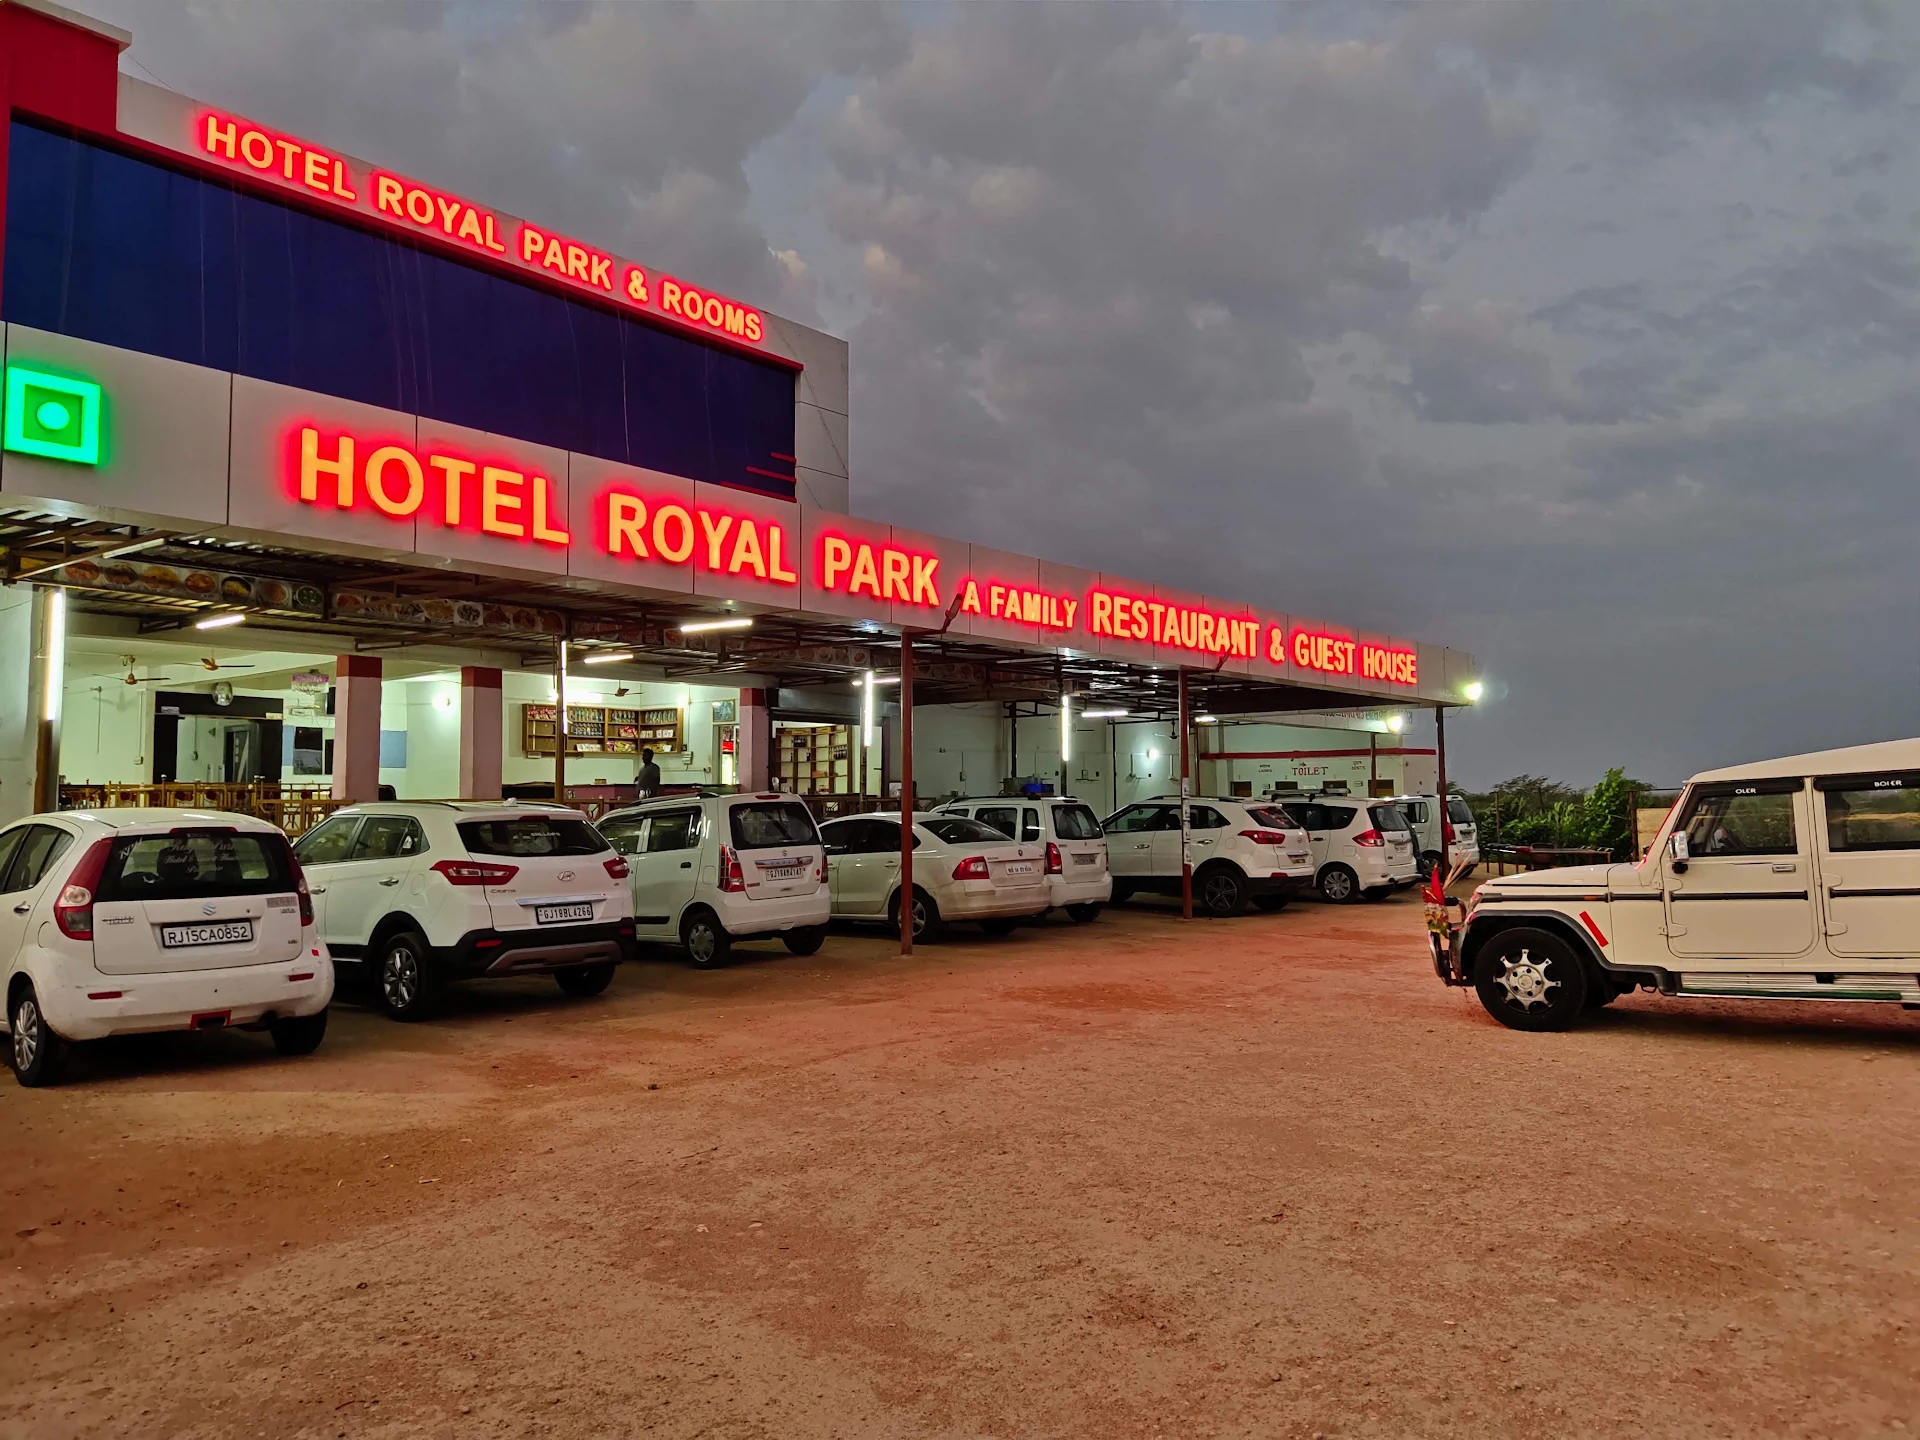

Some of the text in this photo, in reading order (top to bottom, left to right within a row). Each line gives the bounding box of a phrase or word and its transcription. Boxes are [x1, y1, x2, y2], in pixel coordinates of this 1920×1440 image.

[206, 115, 763, 343] HOTEL ROYAL PARK & ROOMS
[299, 427, 1418, 685] HOTEL ROYAL PARK A FAMILY RESTAURANT & GUEST HOUSE
[1291, 766, 1329, 777] TOILET
[168, 926, 248, 944] RJ15CA0852
